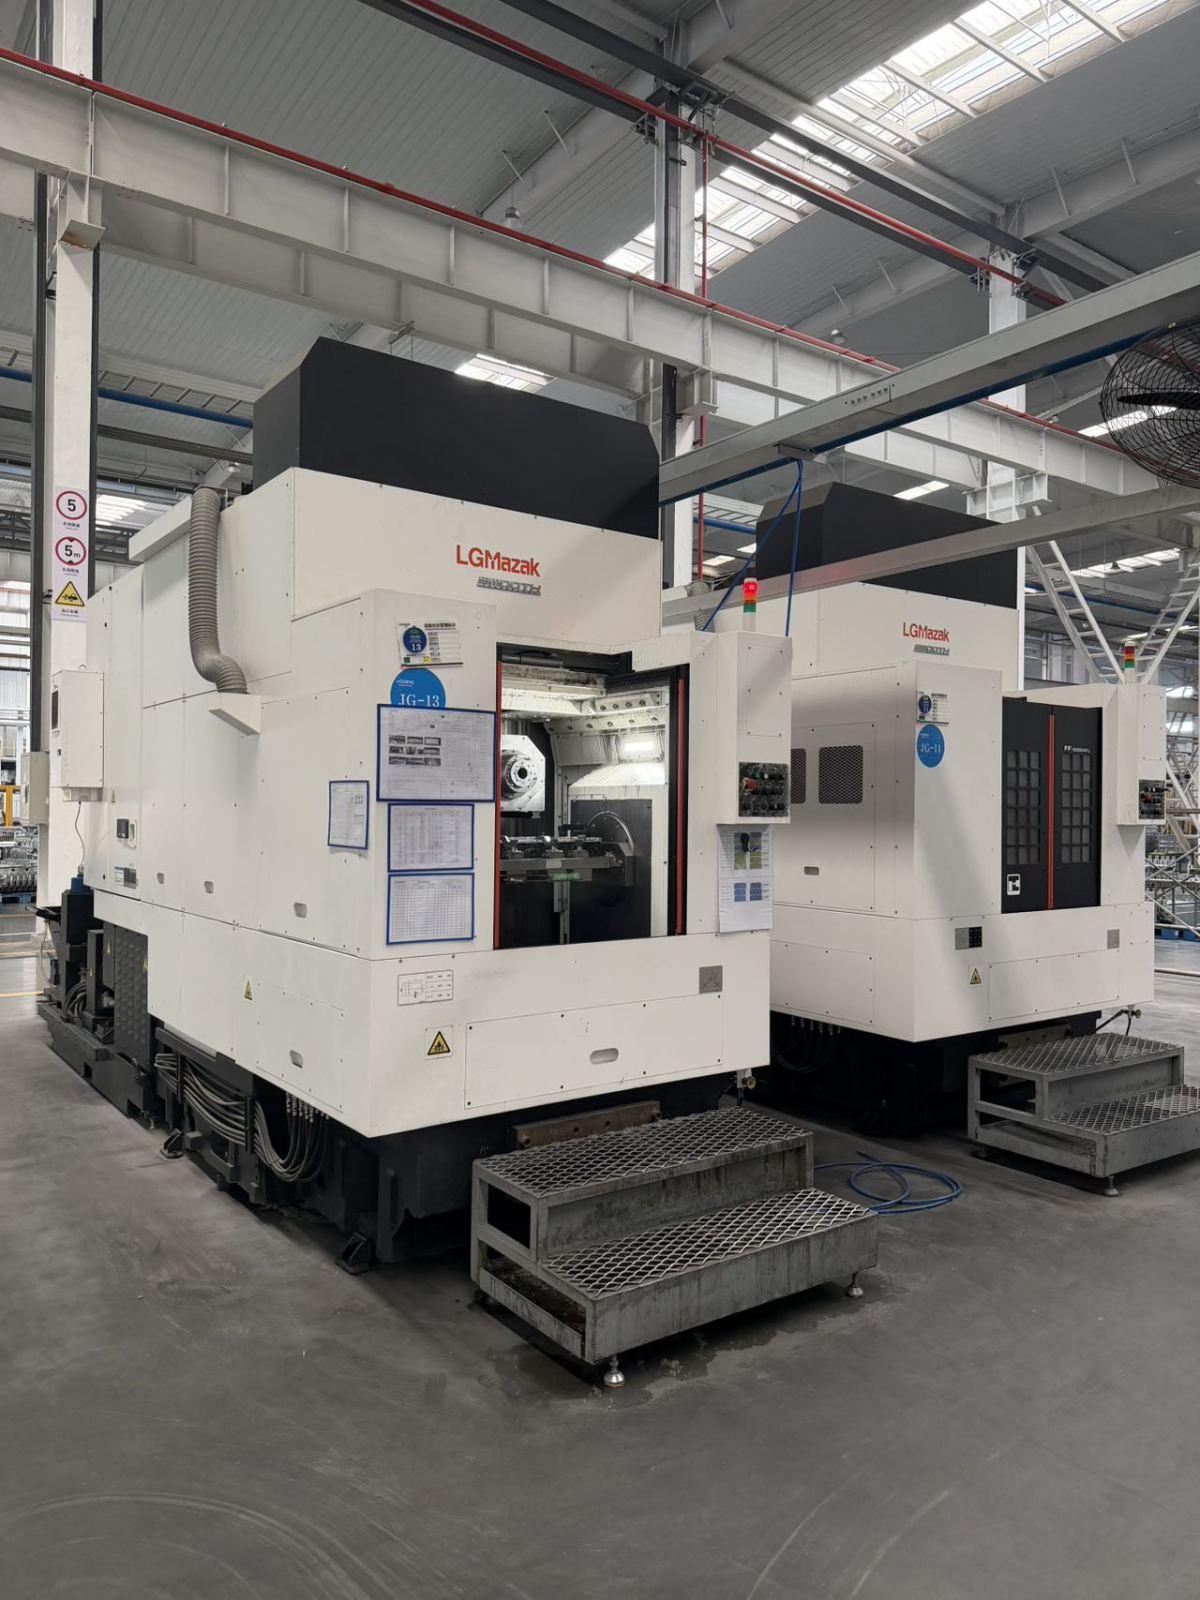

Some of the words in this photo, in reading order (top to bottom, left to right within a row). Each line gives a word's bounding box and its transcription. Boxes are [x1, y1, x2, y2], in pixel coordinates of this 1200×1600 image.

[67, 499, 76, 512] 5
[456, 544, 540, 577] LGMazak
[902, 621, 950, 643] LGMazak
[412, 643, 421, 651] 13
[398, 693, 440, 708] JG-13
[920, 743, 941, 754] JG-11
